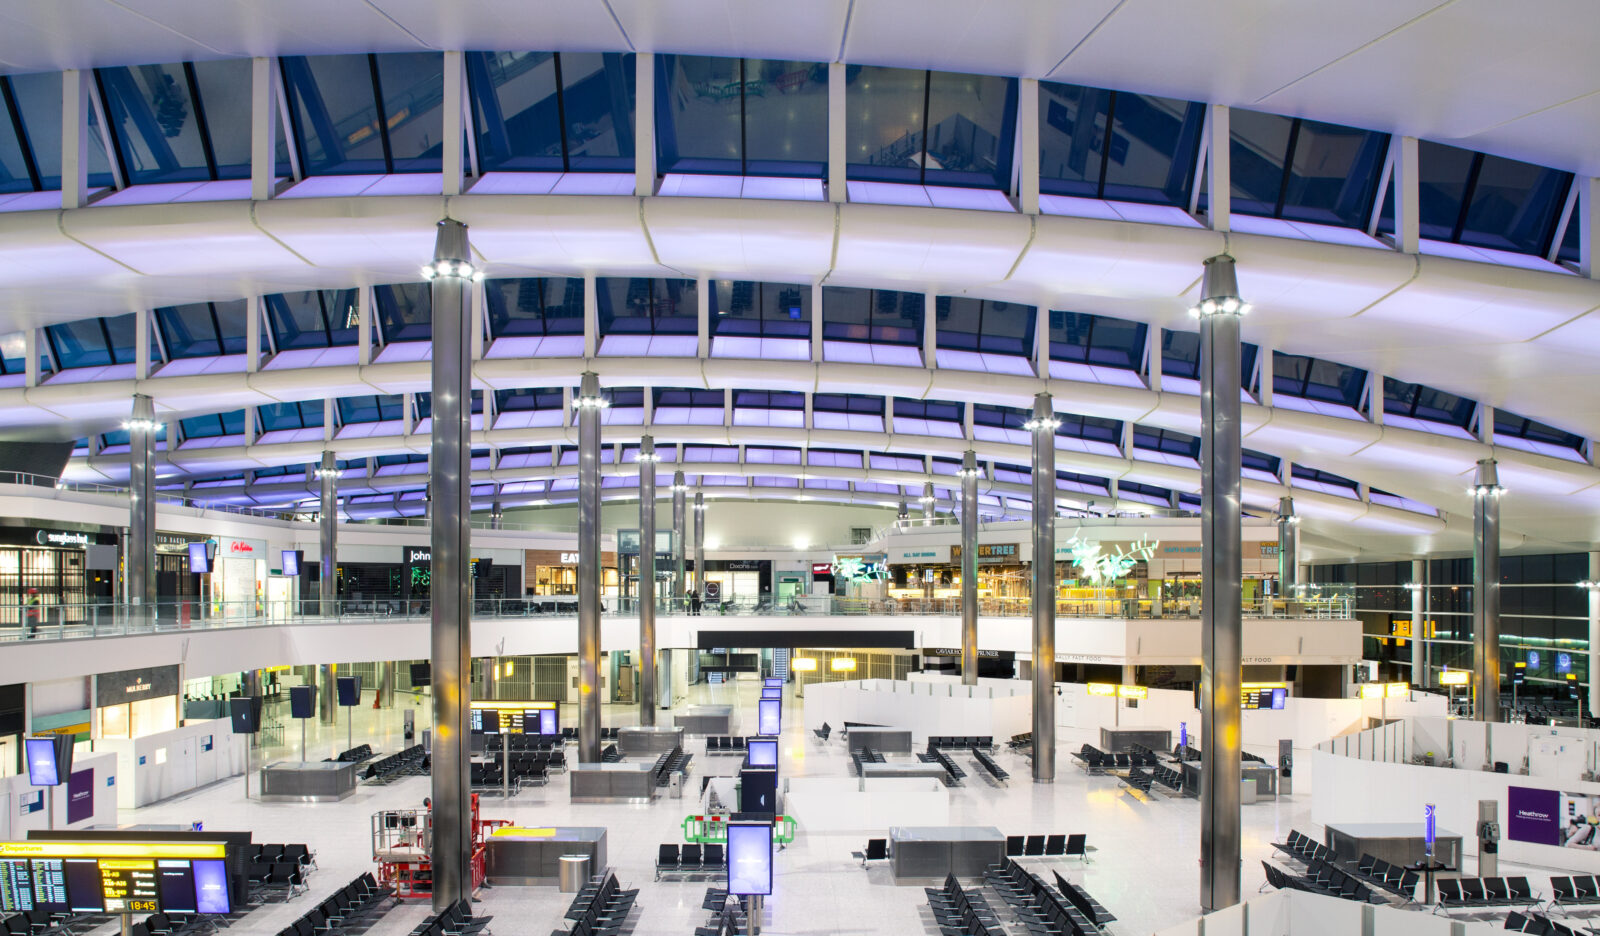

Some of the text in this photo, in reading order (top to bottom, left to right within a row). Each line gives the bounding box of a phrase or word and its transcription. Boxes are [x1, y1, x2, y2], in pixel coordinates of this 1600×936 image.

[48, 532, 88, 545] sunglass hut
[410, 550, 431, 562] John
[126, 683, 151, 693] MULBERRY
[1518, 810, 1549, 818] Heathrow
[5, 845, 43, 853] Departures
[130, 901, 156, 910] 18:45
